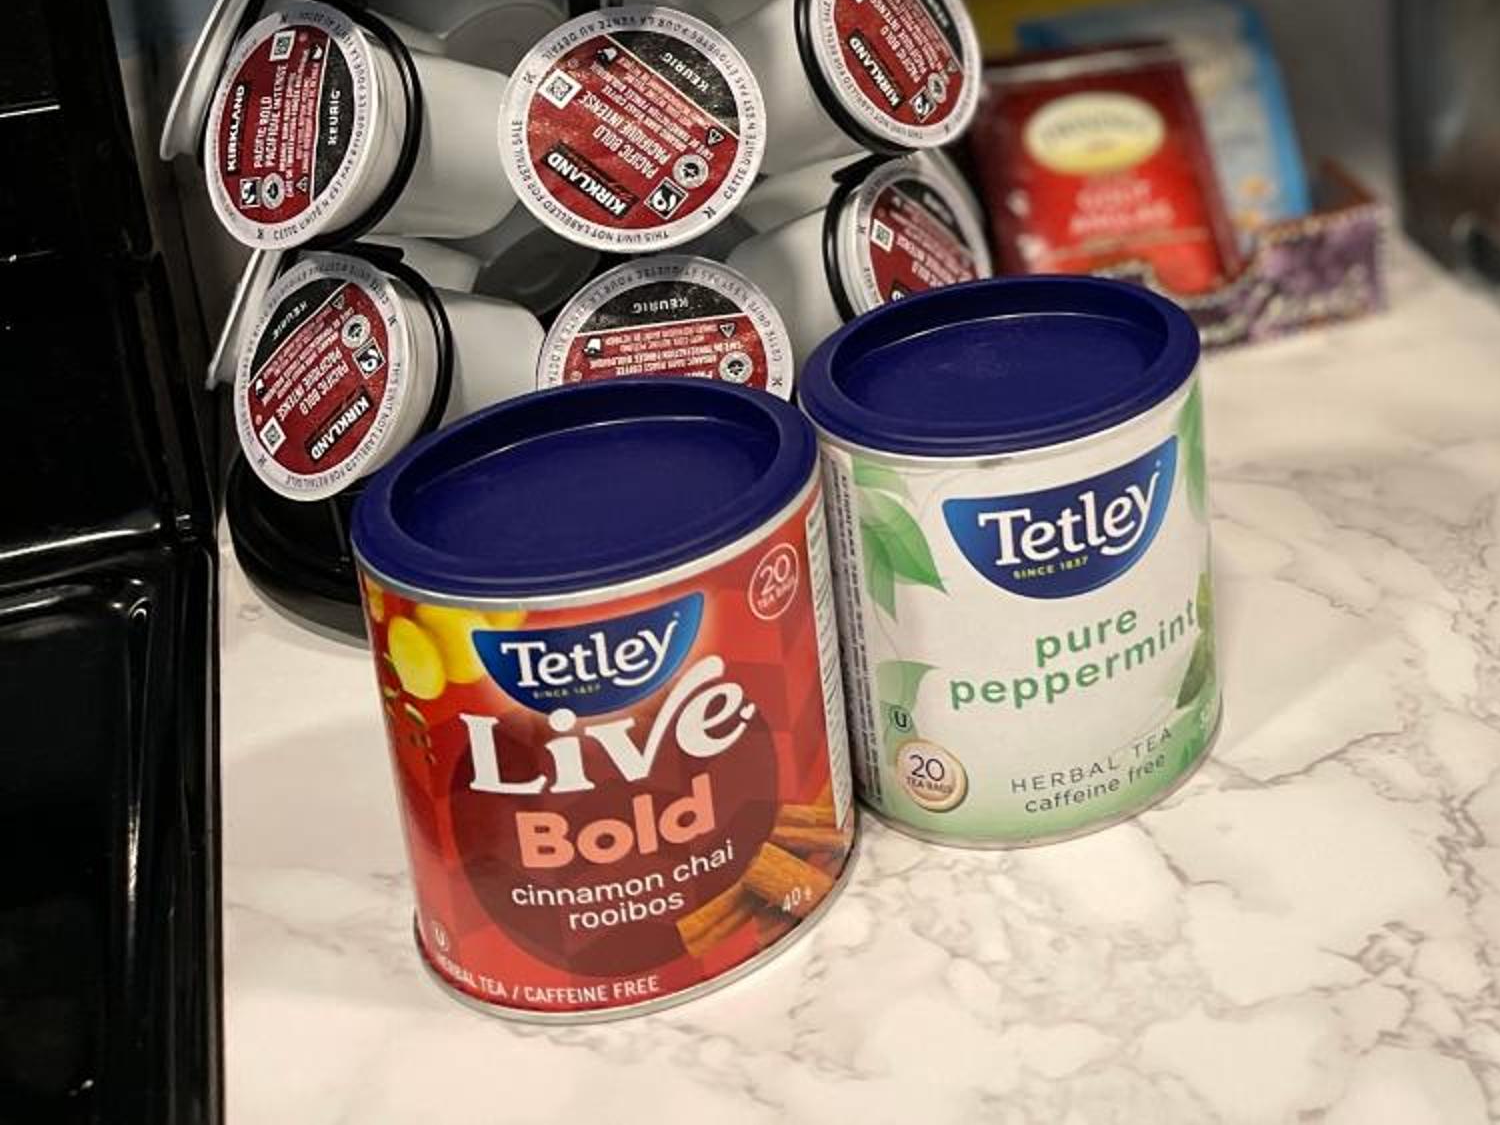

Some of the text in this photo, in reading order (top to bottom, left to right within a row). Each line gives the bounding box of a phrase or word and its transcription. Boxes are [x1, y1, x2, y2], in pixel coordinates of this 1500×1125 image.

[661, 51, 709, 93] KEURIG
[849, 36, 900, 107] KIRKLAND
[227, 85, 245, 172] KIRKLAND
[253, 95, 272, 168] PACIFIC BOLD
[328, 89, 341, 145] KEURIG
[578, 91, 623, 129] INTENSE
[592, 127, 660, 179] PACIFIC BOLD
[620, 122, 672, 166] PACIFIQUE
[546, 151, 627, 215] KIRKLAND
[633, 297, 689, 314] KEURIG
[311, 396, 369, 460] KIRKLAND
[977, 470, 1161, 567] Tetley
[759, 554, 791, 597] 20
[1012, 562, 1056, 580] SINCE
[501, 619, 679, 688] Tetley
[949, 598, 1197, 711] peppermint
[1035, 608, 1138, 669] pure
[910, 753, 946, 782] 20
[1010, 726, 1173, 795] HERBAL TEA
[1024, 754, 1166, 815] caffeine free
[515, 774, 715, 869] Bold
[511, 839, 735, 908] cinnamon chai
[569, 890, 685, 931] rooibos
[478, 974, 508, 998] TEA
[523, 985, 607, 1005] CAFFEINE
[612, 975, 660, 1002] FREE
